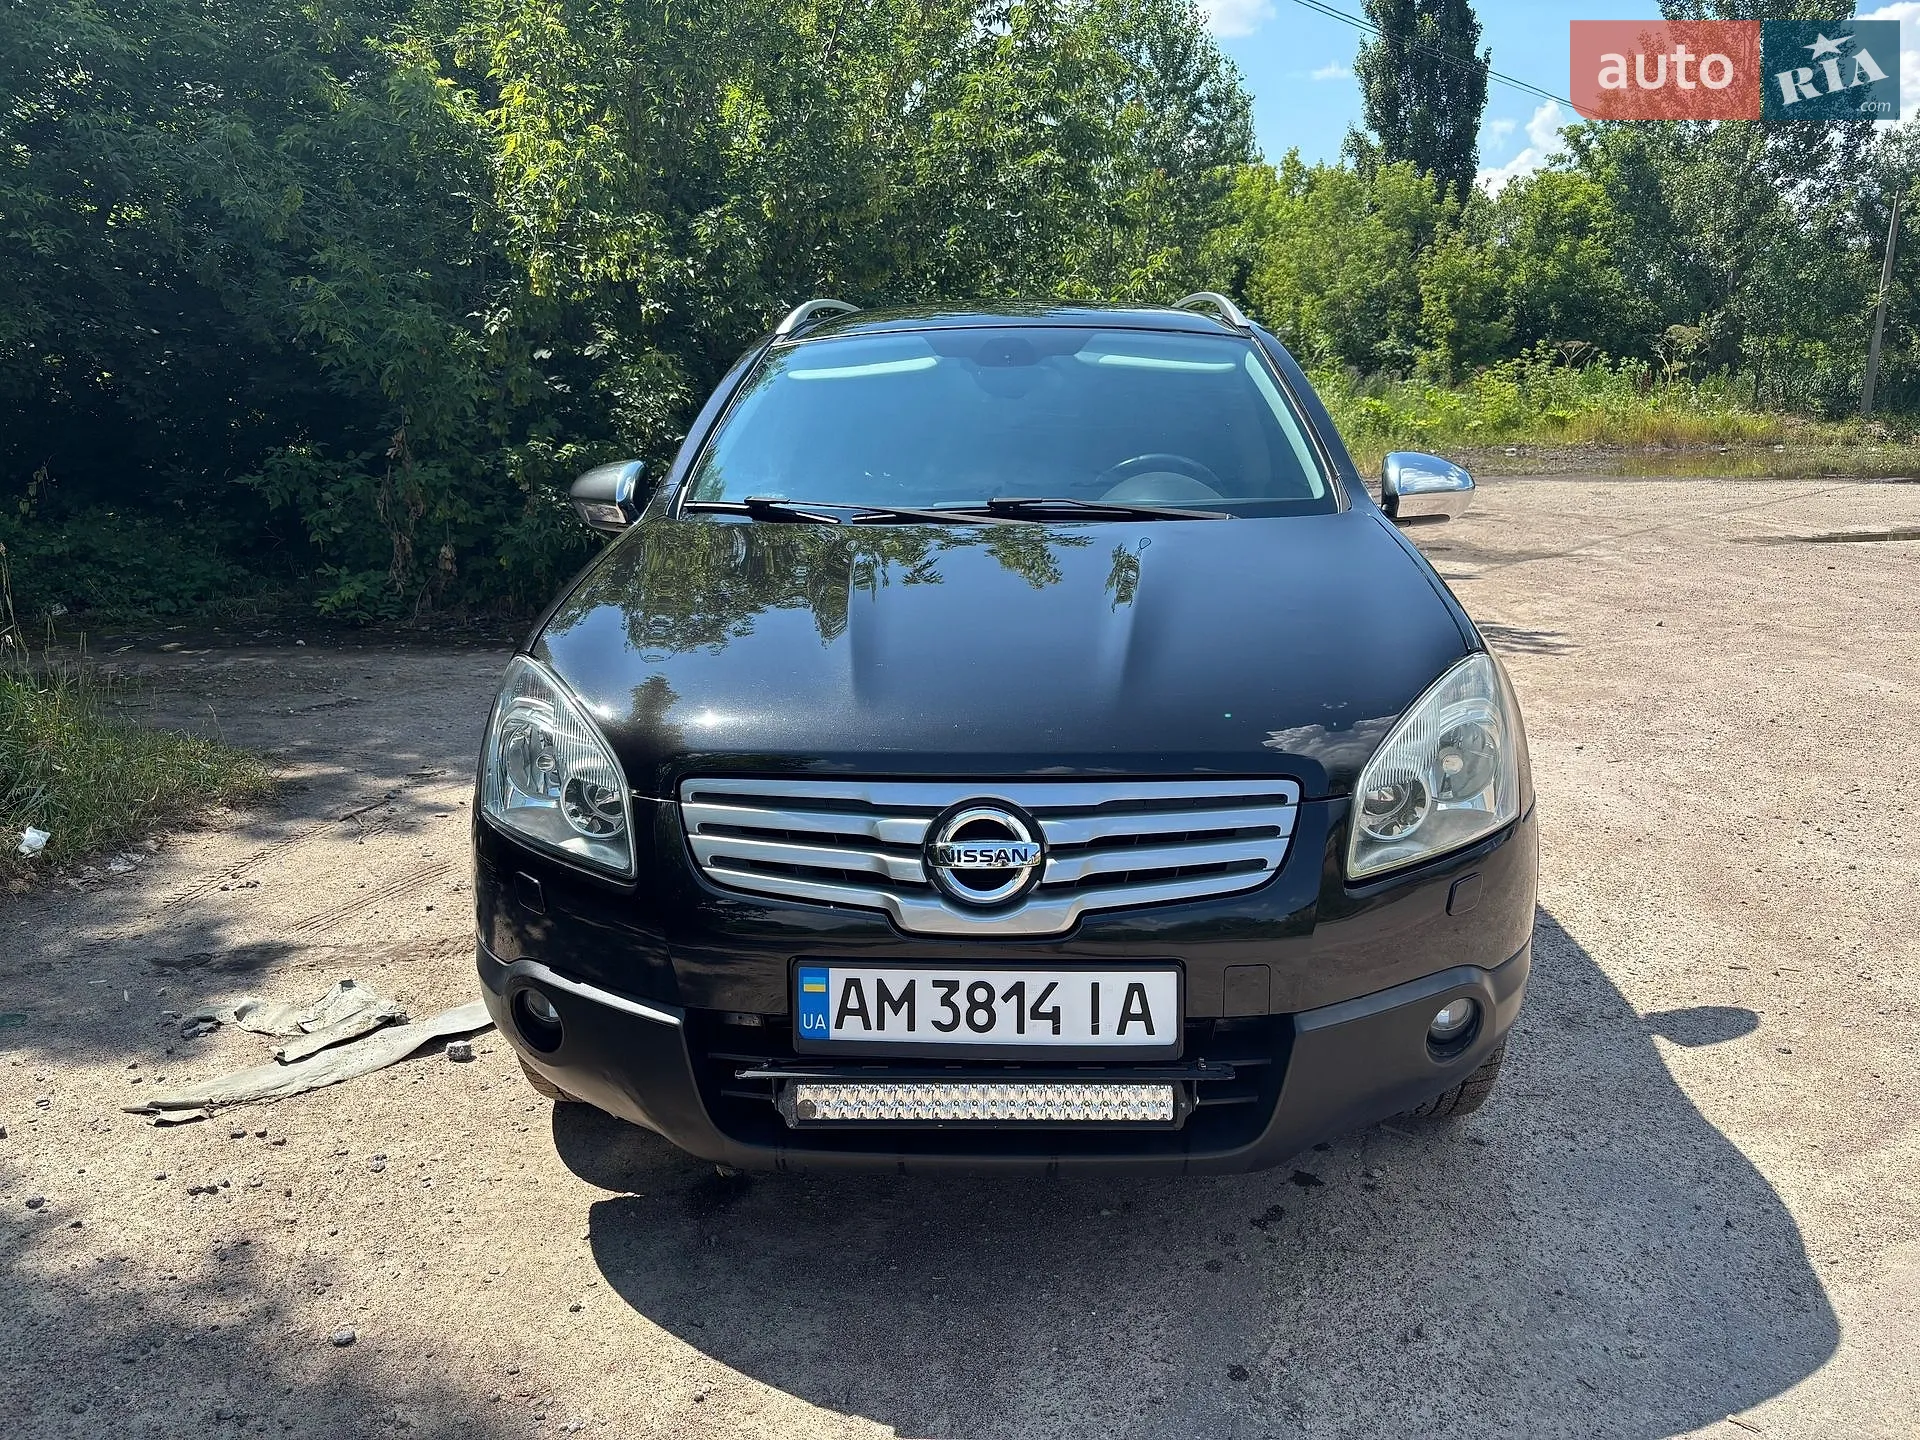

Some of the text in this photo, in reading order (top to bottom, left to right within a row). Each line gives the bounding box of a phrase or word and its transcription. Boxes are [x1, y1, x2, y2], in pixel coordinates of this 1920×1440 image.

[939, 848, 1028, 864] NISSAN
[834, 977, 1156, 1036] AM 3814 IA
[802, 1013, 827, 1031] UA
